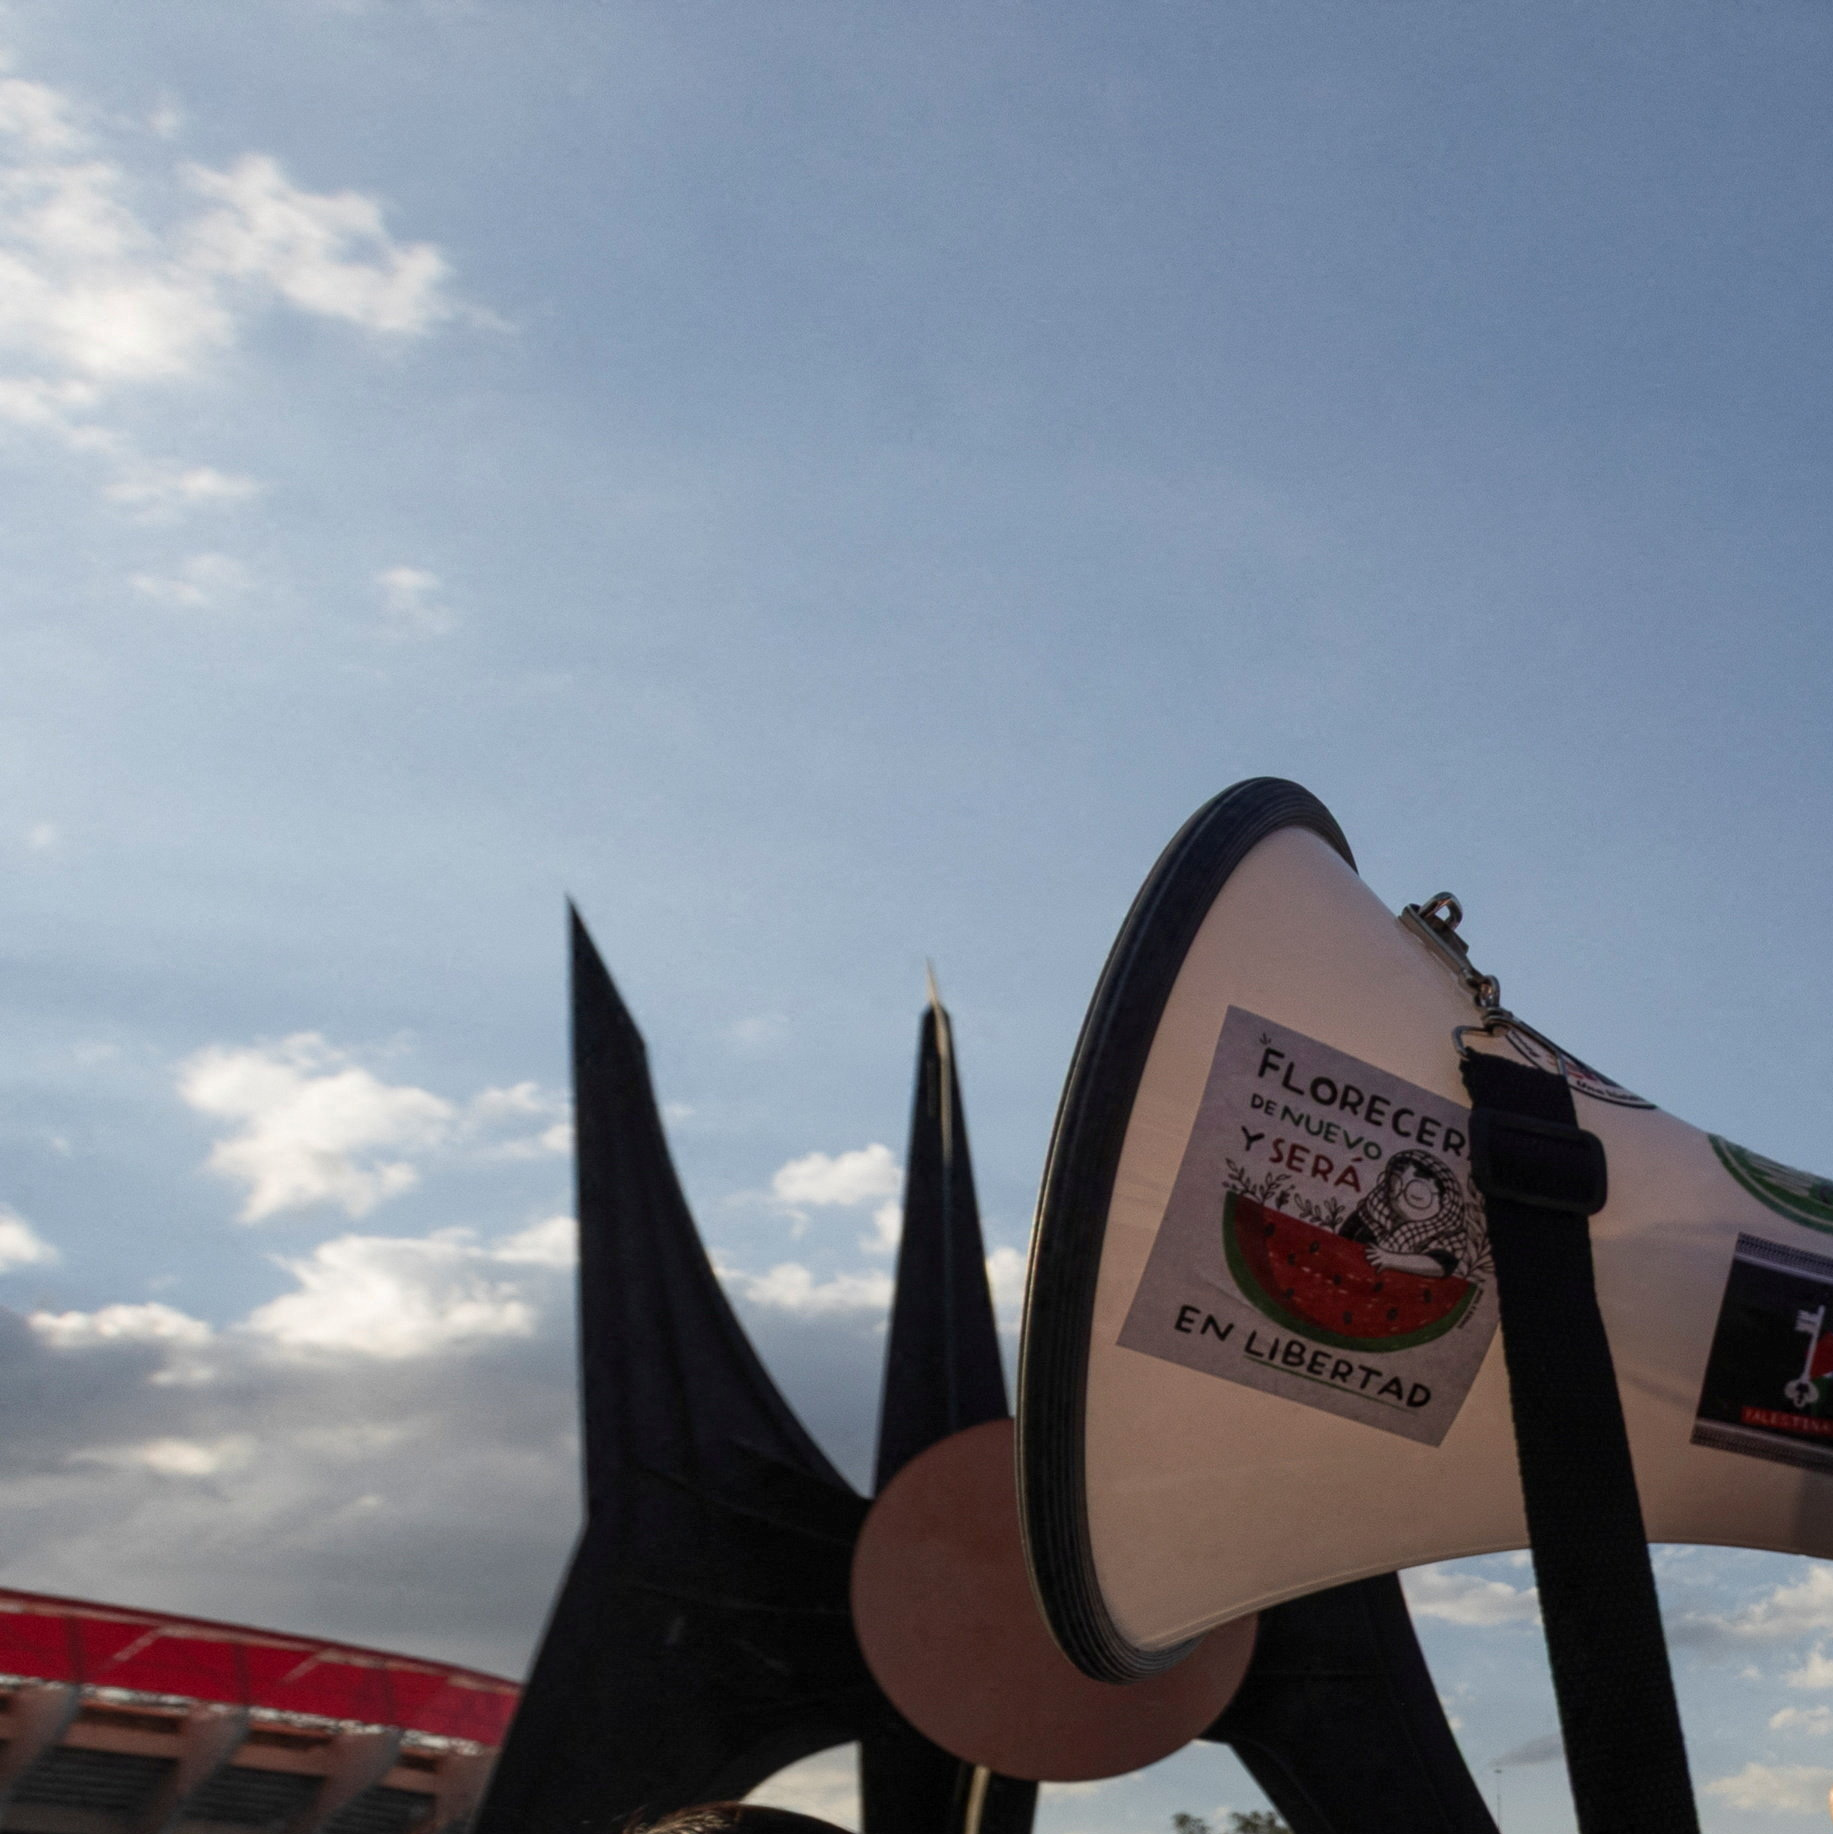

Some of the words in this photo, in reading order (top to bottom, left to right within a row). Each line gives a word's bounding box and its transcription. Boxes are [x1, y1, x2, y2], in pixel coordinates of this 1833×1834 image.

[1250, 1094, 1276, 1117] DE
[1280, 1105, 1383, 1162] NUEVO
[1257, 1047, 1471, 1160] FLORECER
[1241, 1126, 1265, 1152] Y
[1269, 1137, 1362, 1193] SERÁ
[1173, 1304, 1234, 1342] EN
[1243, 1331, 1433, 1409] LIBERTAD
